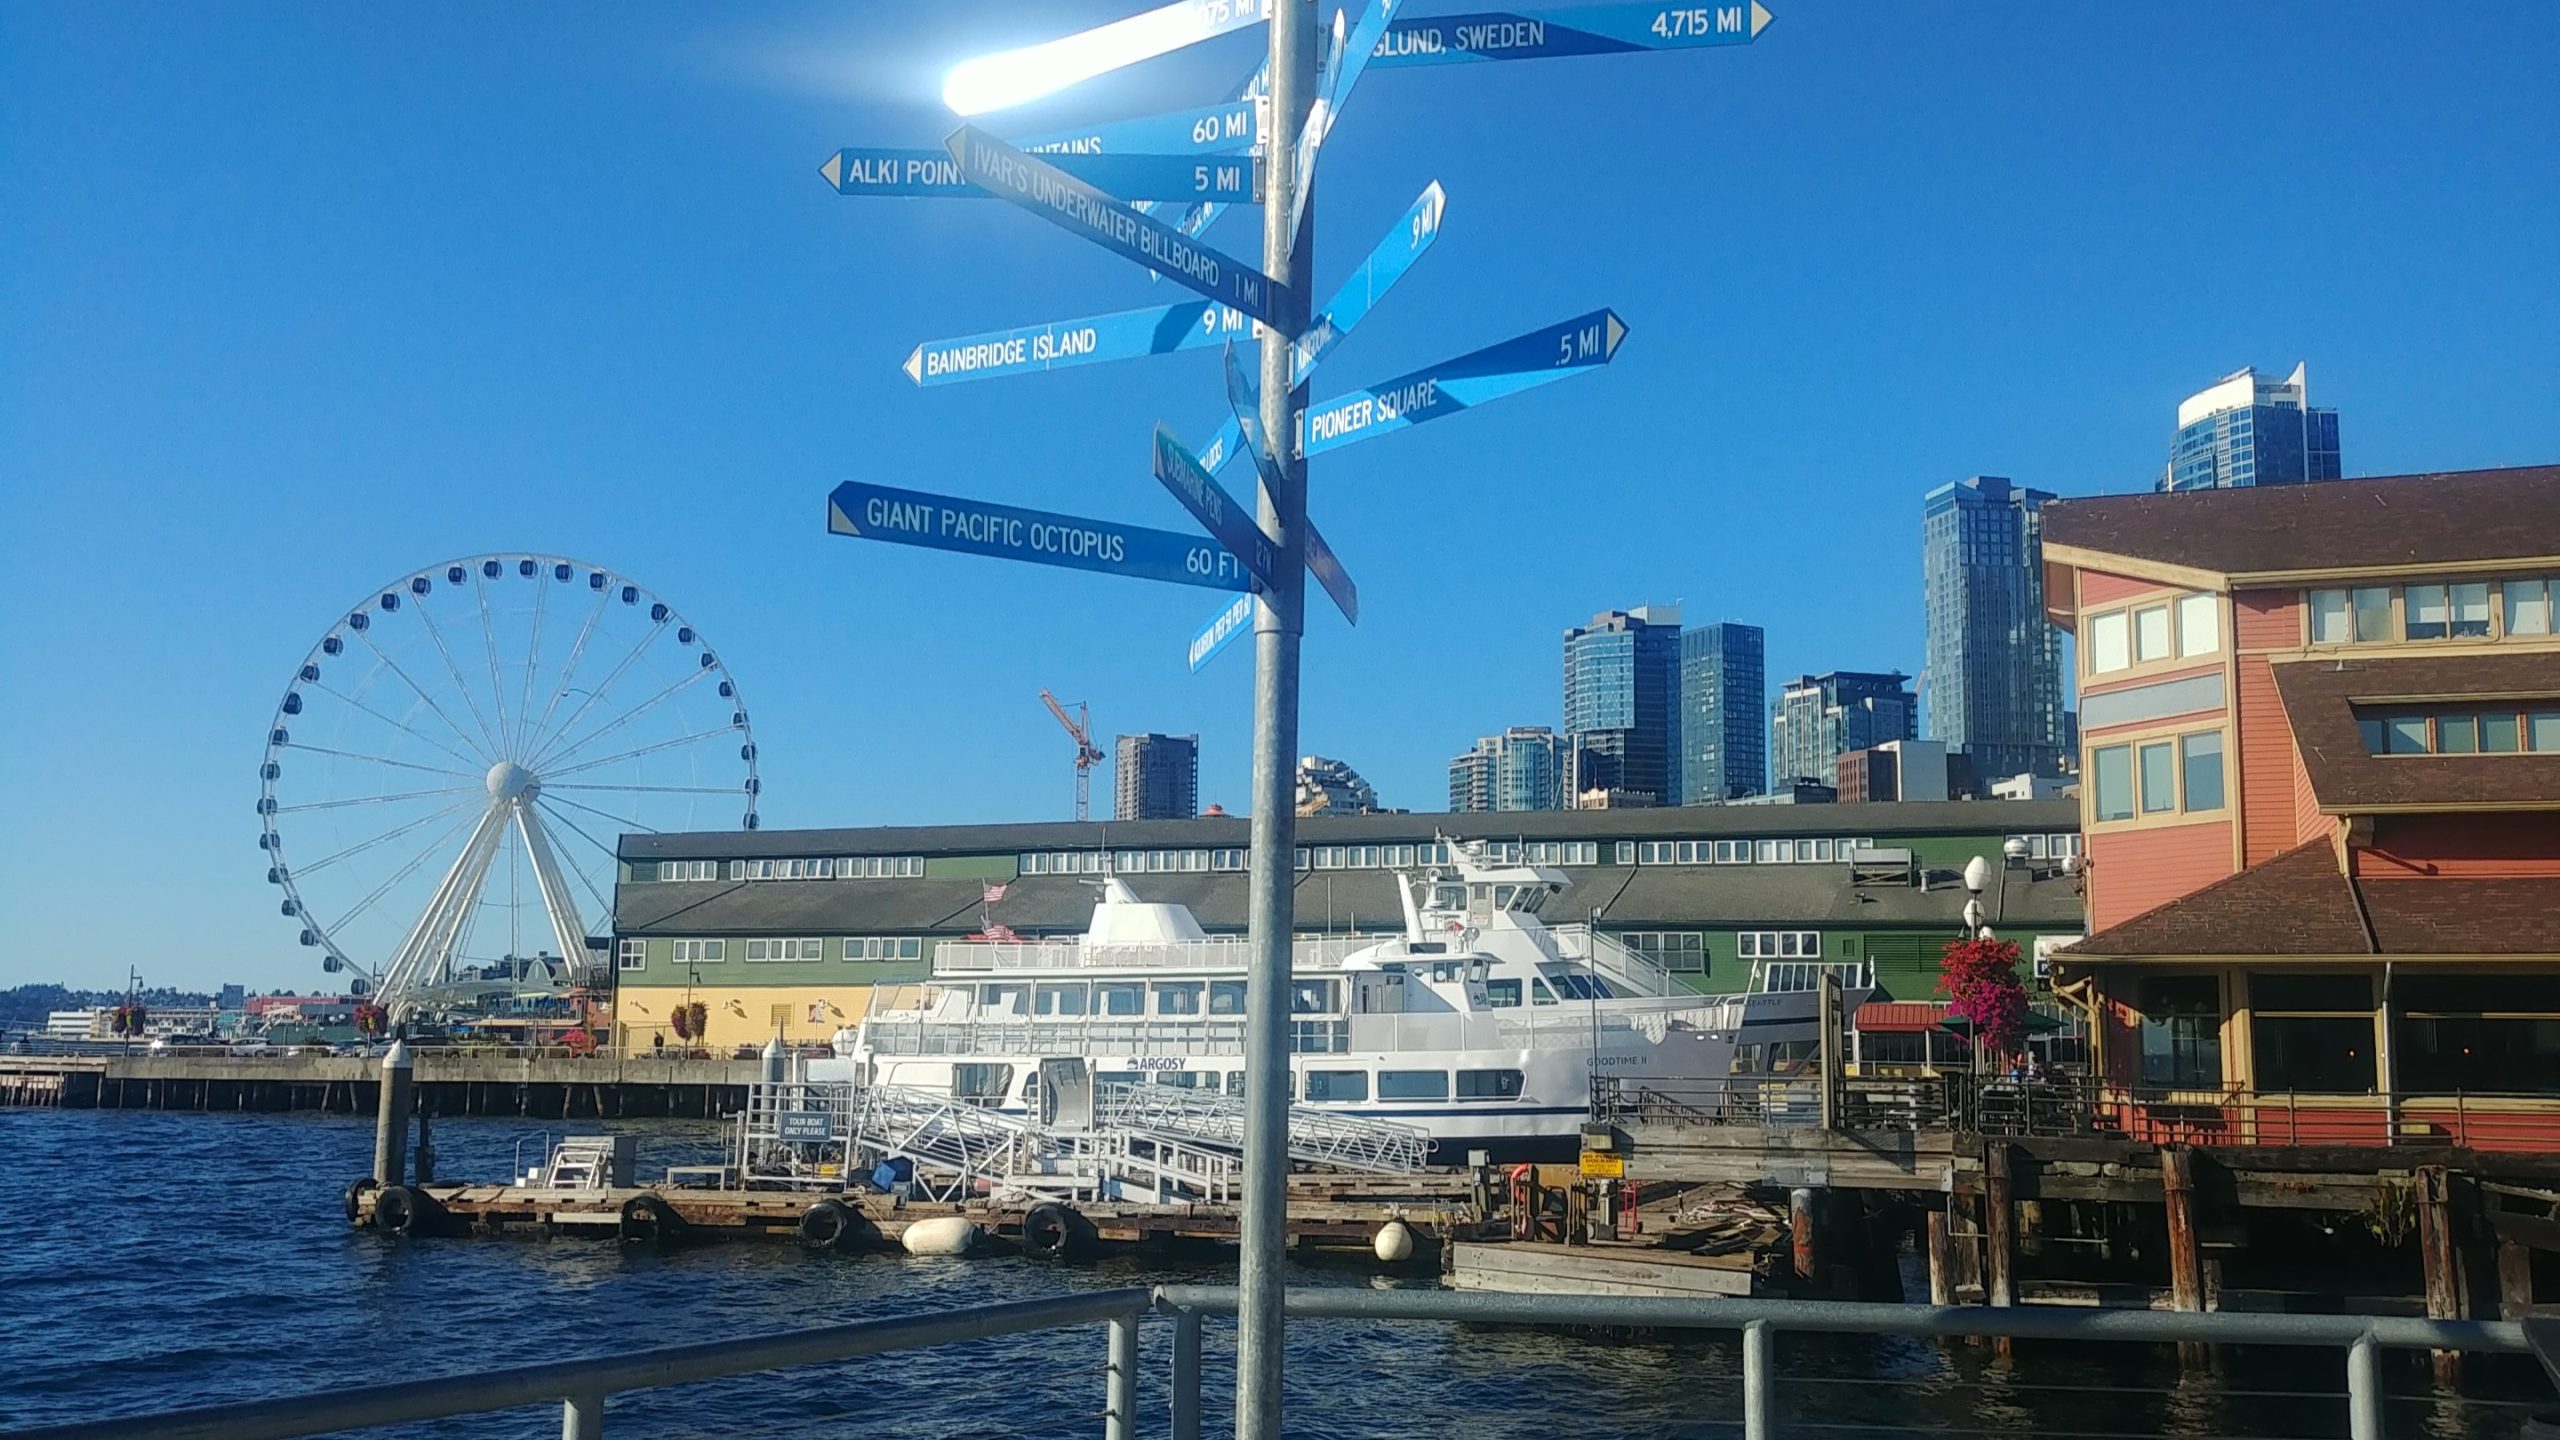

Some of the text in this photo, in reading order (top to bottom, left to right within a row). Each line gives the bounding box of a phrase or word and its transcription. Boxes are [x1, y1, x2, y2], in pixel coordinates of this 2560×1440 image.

[1235, 0, 1255, 17] MI
[1455, 21, 1544, 51] SWEDEN
[1652, 10, 1708, 39] 4,715
[1717, 7, 1742, 34] MI
[1192, 116, 1219, 143] 60
[1226, 111, 1247, 138] MI
[849, 159, 1240, 192] ALKI POIN 5 MI
[974, 143, 1258, 307] IVAR'S UNDERWATER BILLBOARD 1 MI
[1422, 200, 1433, 238] MI
[927, 308, 1243, 376] BAINBRIDGE ISLAND 9 MI
[1312, 325, 1600, 444] PIONEER SQUARE .5 MI
[866, 498, 933, 535] GIANT
[942, 508, 1023, 548] PACIFIC
[1030, 522, 1124, 563] OCTOPUS
[1187, 547, 1212, 574] 60
[1140, 1057, 1186, 1071] ARGOSY
[1586, 1056, 1638, 1067] GOODTIME
[784, 1127, 826, 1136] ONLY PLEASE
[789, 1117, 824, 1127] TOUR BOAT
